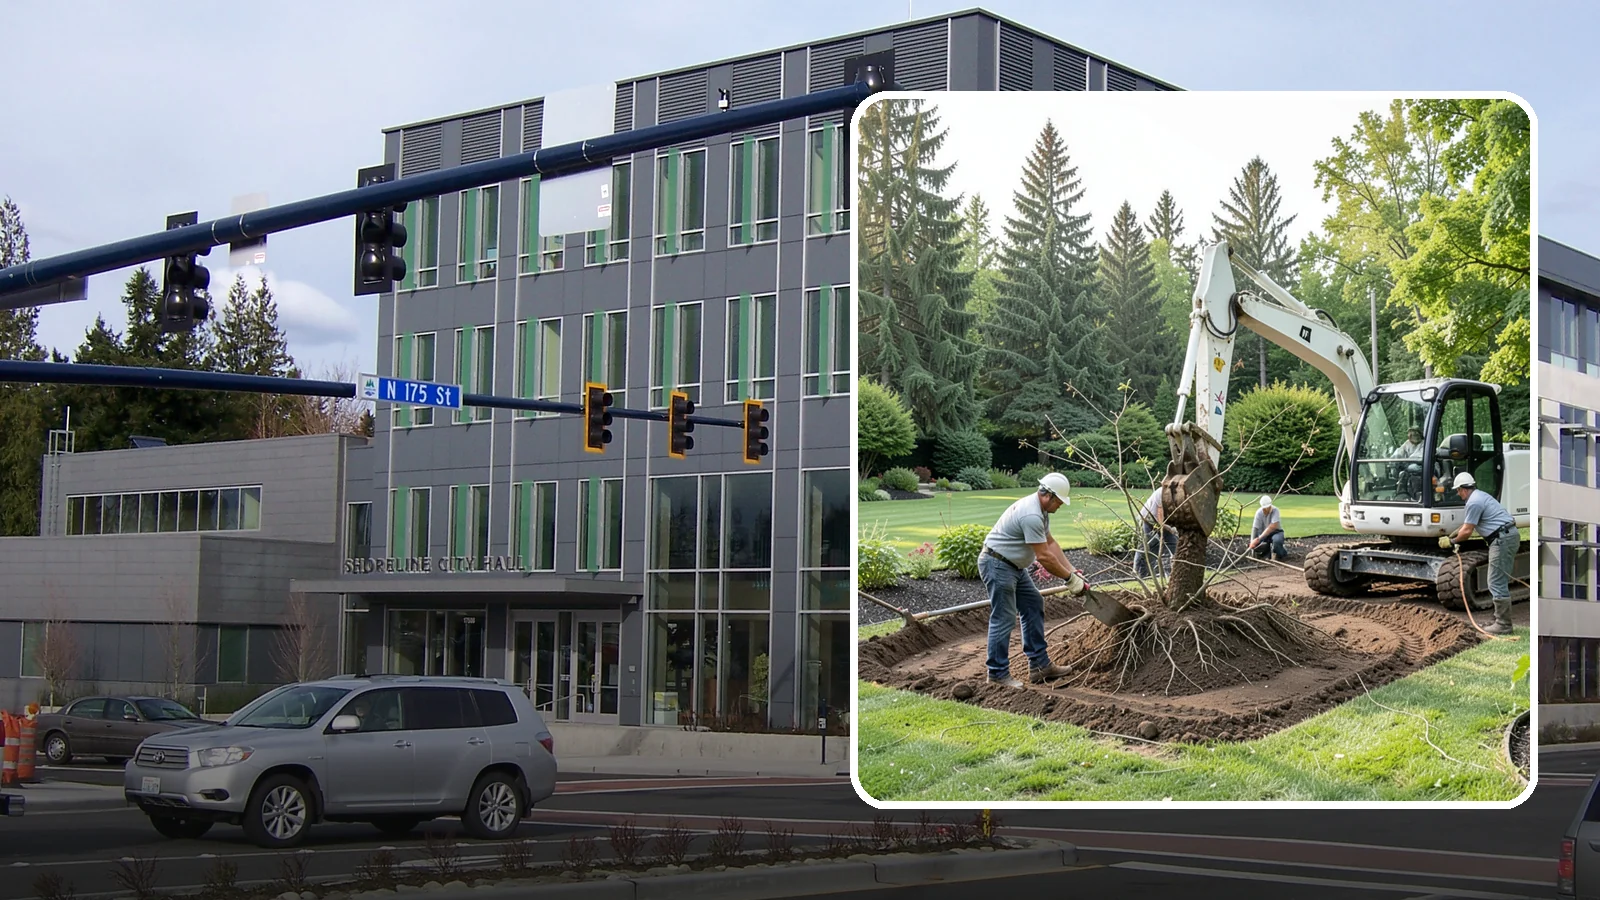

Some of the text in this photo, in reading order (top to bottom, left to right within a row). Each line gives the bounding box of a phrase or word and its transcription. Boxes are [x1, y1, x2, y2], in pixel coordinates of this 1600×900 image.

[387, 380, 452, 406] N 175 St
[344, 555, 526, 574] SHORELINE CITY HALL
